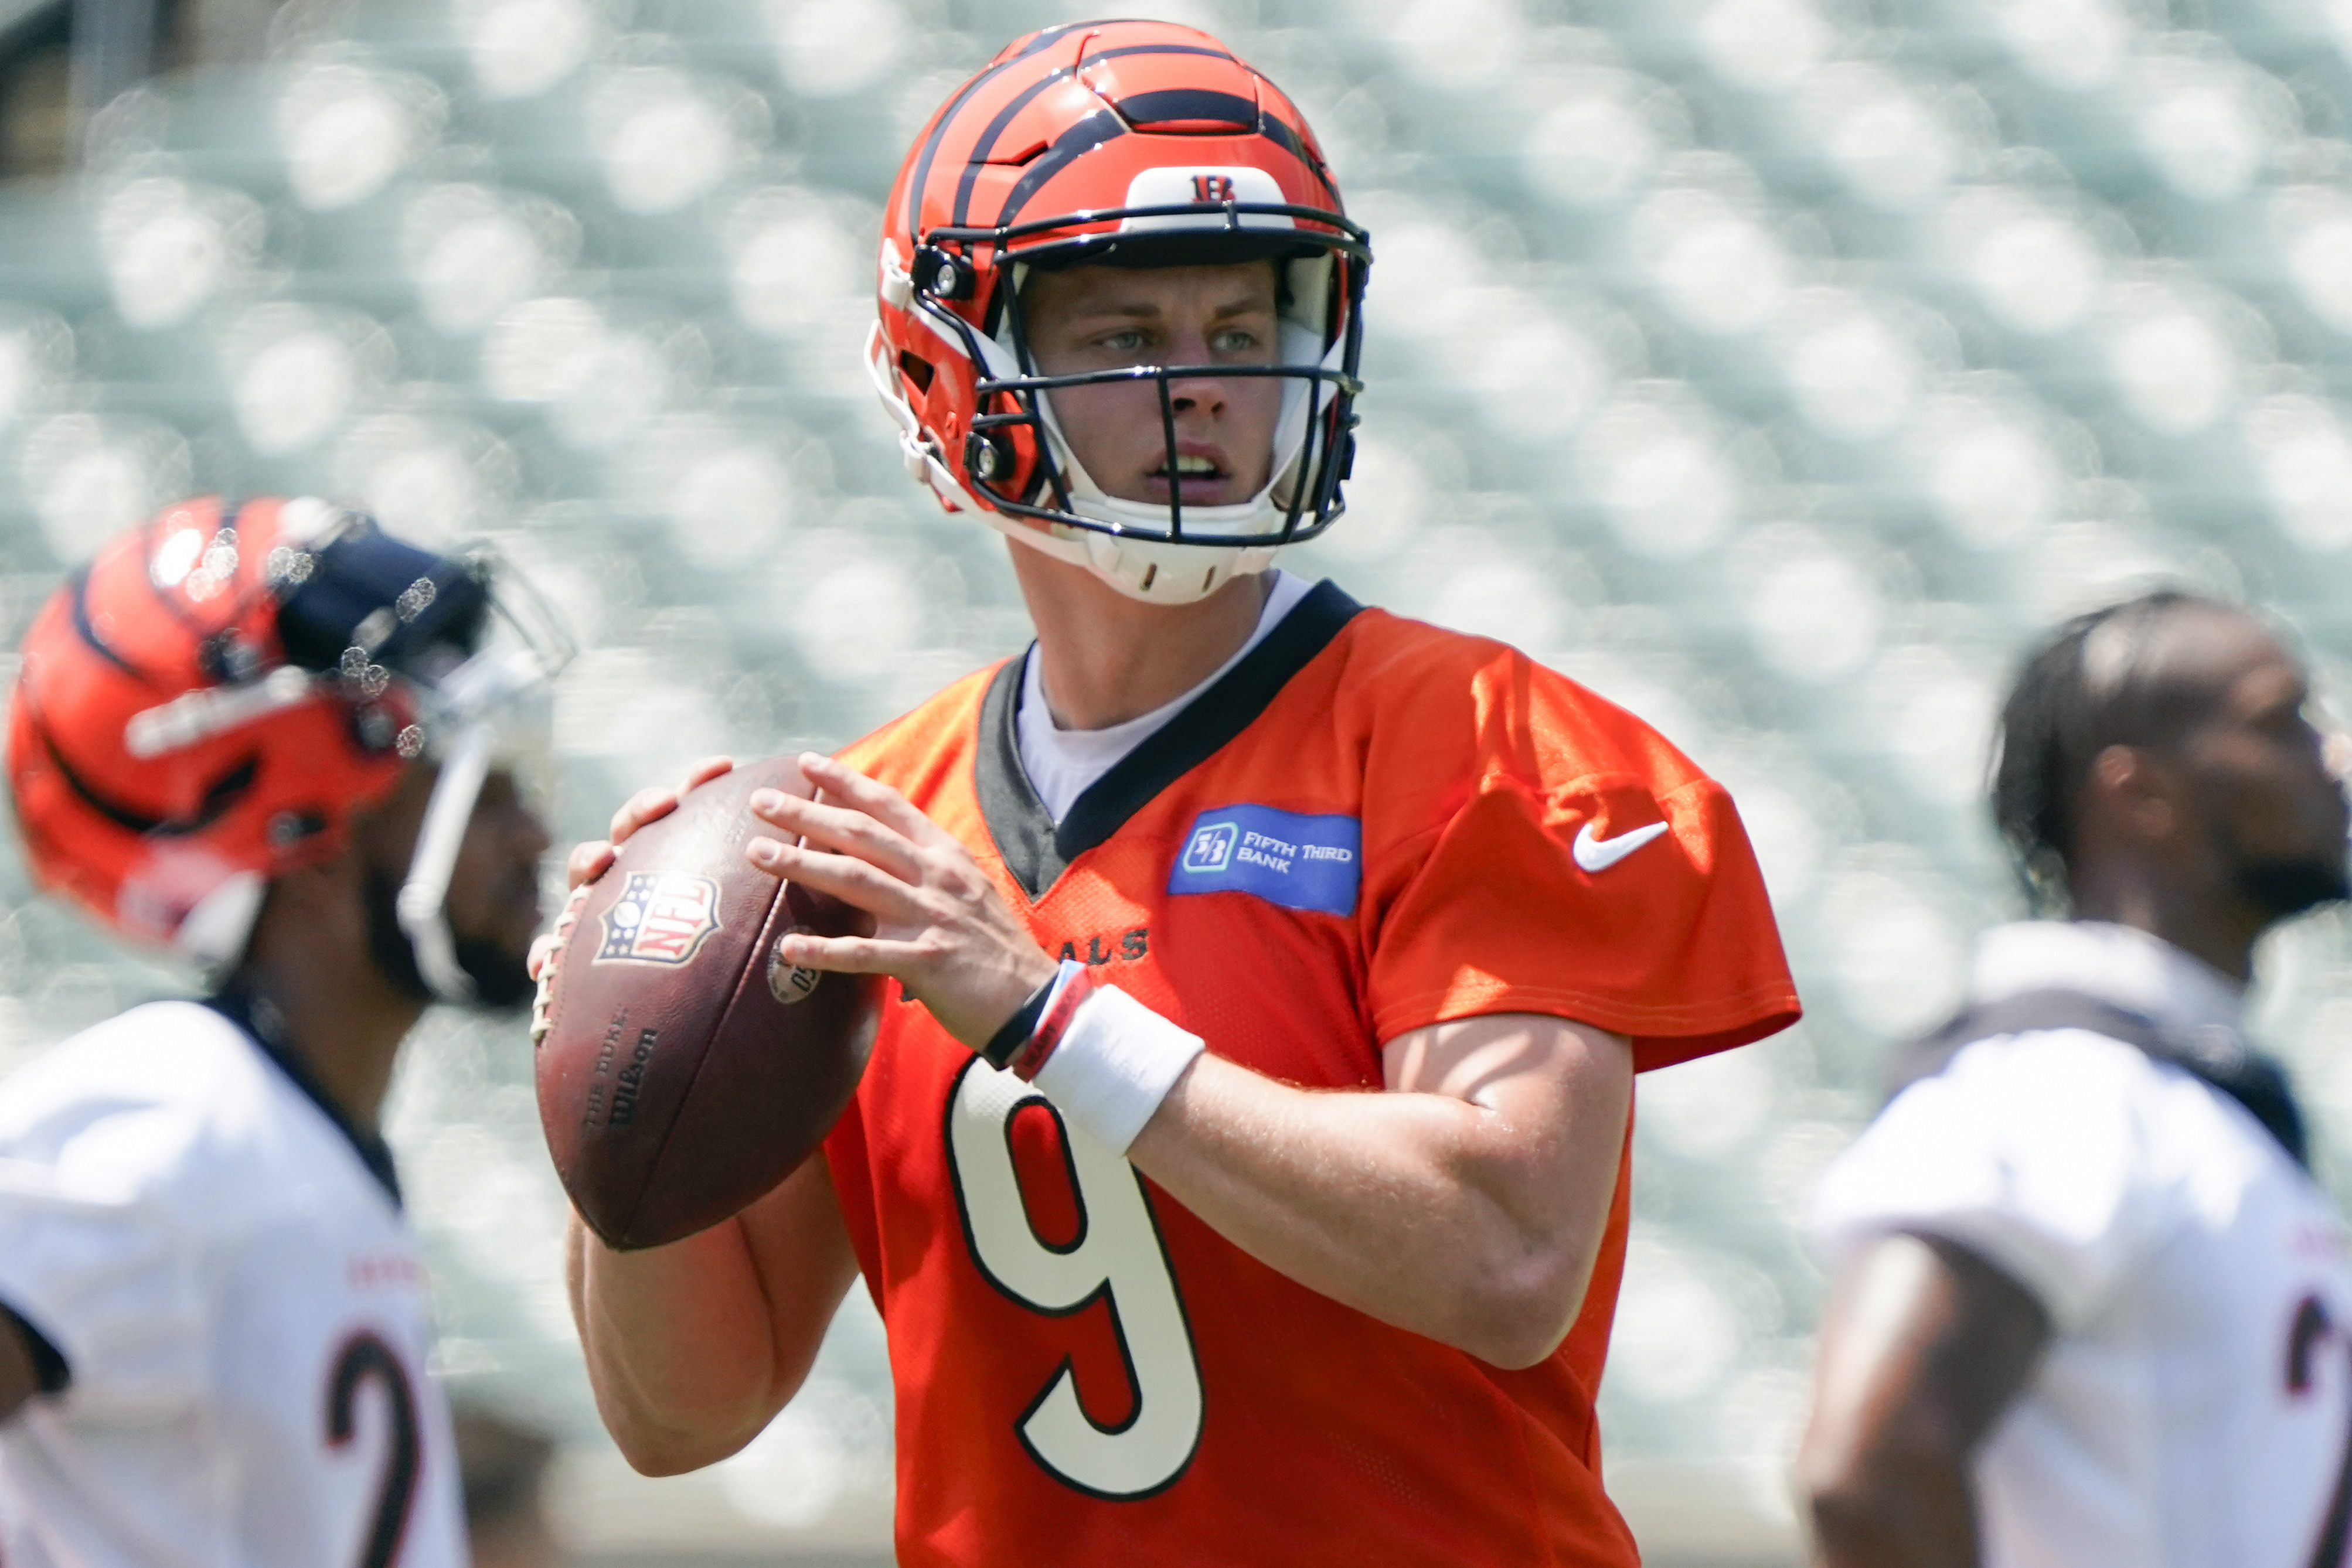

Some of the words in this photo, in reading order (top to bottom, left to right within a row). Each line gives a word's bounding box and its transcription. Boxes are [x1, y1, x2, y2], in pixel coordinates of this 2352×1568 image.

[1236, 847, 1292, 875] BANK
[1243, 831, 1298, 858] FIFTH
[1302, 844, 1353, 863] THIRD
[638, 885, 706, 956] NFL
[1042, 928, 1149, 966] ALS
[608, 1028, 658, 1125] Wilson
[942, 1054, 1205, 1502] 9
